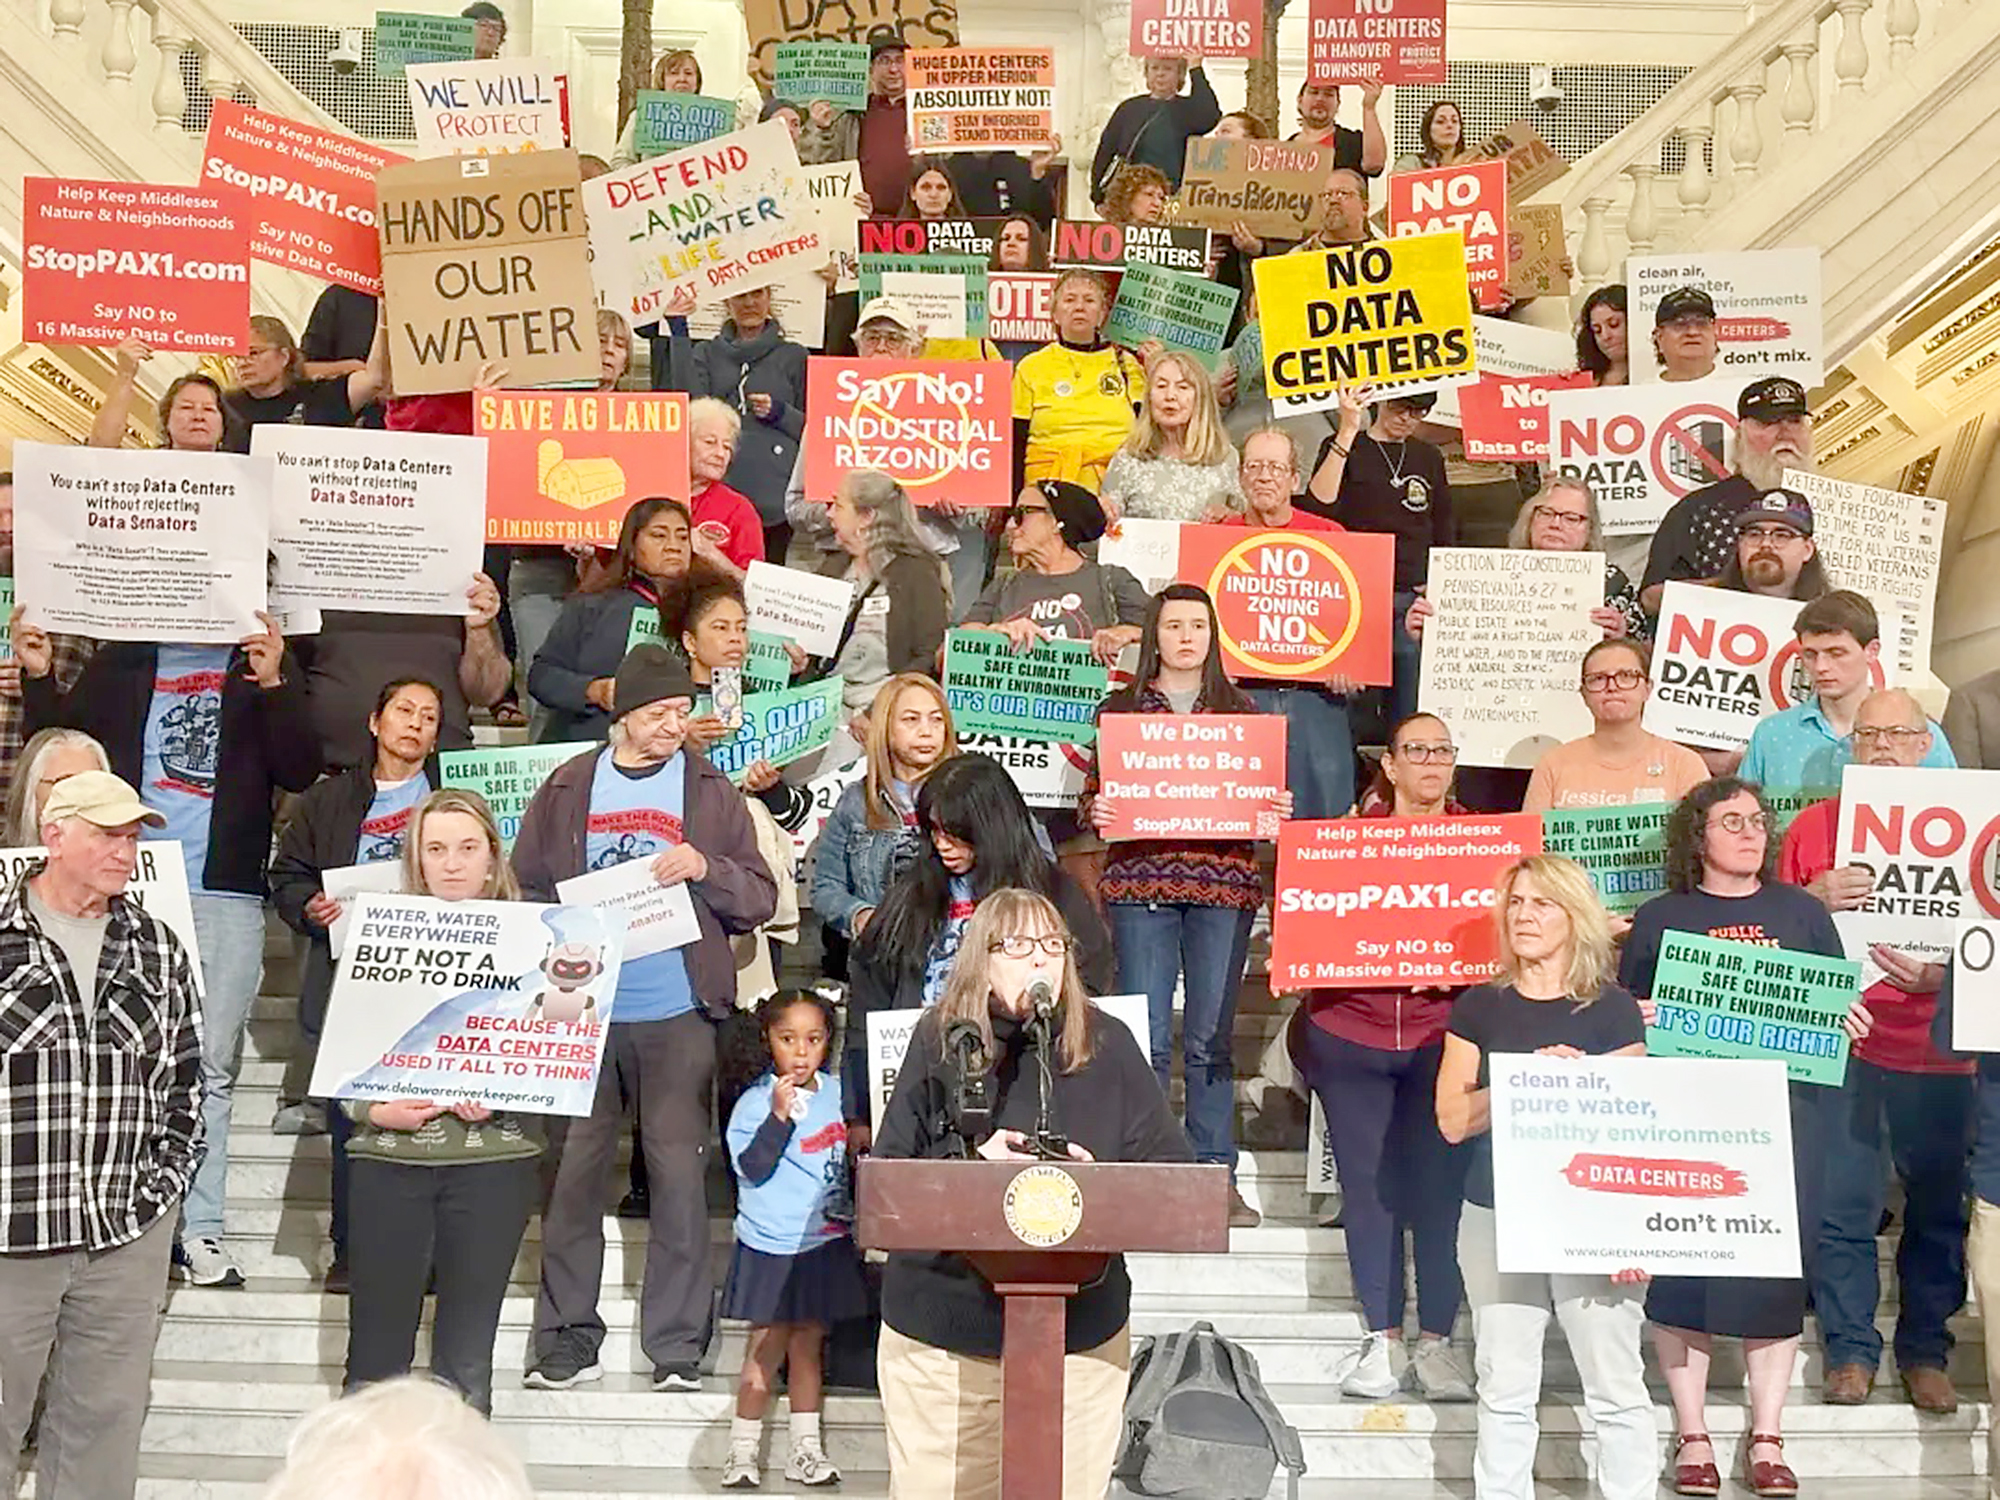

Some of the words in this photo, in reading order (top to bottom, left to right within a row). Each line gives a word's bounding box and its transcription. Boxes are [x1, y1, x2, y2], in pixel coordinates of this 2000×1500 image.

[1142, 21, 1250, 46] CENTERS
[1314, 19, 1358, 38] DATA
[1364, 18, 1441, 38] CENTERS
[913, 57, 949, 70] HUGE
[951, 56, 986, 69] DATA
[990, 55, 1049, 68] CENTERS
[1314, 43, 1326, 58] IN
[1331, 42, 1391, 57] HANOVER
[1314, 64, 1383, 78] TOWNSHIP.
[415, 78, 469, 108] WE
[476, 75, 552, 106] WILL
[913, 90, 1011, 108] ABSOLUTELY
[1016, 90, 1051, 107] NOT!
[437, 113, 542, 139] PROTECT
[606, 145, 749, 208] DEFEND
[58, 186, 95, 202] Help
[98, 189, 137, 206] Keep
[141, 190, 219, 209] Middlesex
[1412, 174, 1481, 213] NO
[41, 205, 94, 221] Nature
[98, 208, 112, 222] &
[116, 208, 234, 231] Neighborhoods
[382, 193, 504, 244] HANDS
[517, 188, 576, 233] OFF
[677, 197, 784, 245] WATER
[862, 222, 926, 255] NO
[927, 222, 975, 238] DATA
[1058, 220, 1122, 262] NO
[1125, 226, 1172, 246] DATA
[28, 244, 247, 283] StopPAX1.com
[659, 238, 726, 280] LIFE
[707, 261, 749, 287] DATA
[747, 233, 820, 265] CENTERS
[1124, 245, 1203, 268] CENTERS.
[1325, 246, 1392, 289] NO
[434, 255, 536, 300] OUR
[1638, 267, 1677, 278] clean
[1683, 265, 1705, 278] air,
[94, 303, 126, 321] Say
[128, 305, 155, 321] NO
[159, 308, 177, 323] to
[1306, 289, 1423, 339] DATA
[36, 321, 54, 336] 16
[60, 324, 126, 341] Massive
[173, 330, 235, 348] Centers
[404, 306, 582, 366] WATER
[1271, 329, 1469, 389] CENTERS
[1724, 351, 1769, 365] don't
[1775, 349, 1811, 362] mix.
[836, 369, 906, 411] Say
[916, 373, 984, 405] No!
[1500, 383, 1549, 408] No
[480, 396, 555, 431] SAVE
[562, 398, 598, 431] AG
[607, 398, 682, 432] LAND
[1519, 418, 1538, 430] to
[824, 415, 1002, 442] INDUSTRIAL
[1560, 414, 1645, 457] NO
[834, 446, 991, 471] REZONING
[1469, 440, 1516, 455] Data
[50, 473, 71, 490] You
[76, 478, 109, 492] can't
[112, 482, 141, 495] stop
[143, 478, 177, 494] Data
[180, 479, 235, 497] Centers
[1785, 472, 1853, 499] VETERANS
[1862, 488, 1914, 510] FOUGHT
[86, 497, 141, 512] without
[142, 499, 200, 515] rejecting
[87, 512, 125, 530] Data
[130, 514, 197, 532] Senators
[502, 518, 604, 539] INDUSTRIAL
[1834, 516, 1858, 535] TIME
[1864, 525, 1886, 539] FOR
[1894, 529, 1910, 543] US
[1260, 548, 1310, 578] NO
[1840, 537, 1862, 552] FOR
[1867, 541, 1882, 557] ALL
[1886, 546, 1937, 565] VETERANS
[1867, 558, 1929, 580] VETERANS
[1226, 576, 1345, 599] INDUSTRIAL
[1845, 572, 1878, 589] THEIR
[1882, 578, 1923, 598] RIGHTS
[1247, 596, 1320, 616] ZONING
[1258, 614, 1307, 643] NO
[1667, 613, 1769, 667] NO
[1240, 640, 1270, 653] DATA
[1271, 642, 1325, 656] CENTERS
[1661, 659, 1763, 700] DATA
[768, 695, 826, 733] OUR
[1656, 686, 1761, 718] CENTERS
[1139, 722, 1176, 741] We
[1182, 722, 1244, 741] Don't
[711, 722, 814, 772] RIGHT!
[1121, 751, 1182, 770] Want
[1186, 754, 1210, 770] to
[1216, 752, 1244, 770] Be
[1249, 756, 1262, 770] a
[1104, 781, 1150, 798] Data
[1154, 781, 1219, 798] Center
[1222, 782, 1277, 799] Town
[1554, 789, 1627, 807] Jessica
[1133, 817, 1250, 835] StopPAX1.com
[1552, 821, 1580, 835] AIR,
[1586, 818, 1621, 833] PURE
[1851, 803, 1967, 859] NO
[1542, 838, 1575, 852] SAFE
[1581, 834, 1640, 851] CLIMATE
[366, 907, 431, 925] WATER,
[436, 912, 501, 930] WATER,
[1708, 925, 1765, 938] PUBLIC
[361, 923, 499, 946] EVERYWHERE
[354, 945, 410, 967] BUT
[415, 947, 471, 971] NOT
[477, 953, 496, 971] A
[1665, 944, 1712, 966] CLEAN
[1716, 954, 1747, 974] AIR,
[1754, 959, 1795, 981] PURE
[1800, 968, 1855, 989] WATER
[350, 965, 413, 984] DROP
[418, 969, 448, 987] TO
[453, 973, 524, 993] DRINK
[1701, 972, 1738, 991] SAFE
[1744, 978, 1810, 1004] CLIMATE
[1657, 984, 1724, 1010] HEALTHY
[1729, 997, 1848, 1030] ENVIRONMENTS
[465, 1015, 558, 1036] BECAUSE
[564, 1021, 602, 1039] THE
[1655, 1004, 1699, 1035] IT'S
[1706, 1014, 1755, 1045] OUR
[1760, 1022, 1841, 1059] RIGHT!
[435, 1035, 492, 1054] DATA
[499, 1040, 598, 1061] CENTERS
[381, 1053, 433, 1071] USED
[437, 1057, 455, 1072] IT
[459, 1058, 498, 1076] ALL
[502, 1062, 529, 1077] TO
[535, 1063, 593, 1082] THINK
[350, 1080, 556, 1107] www.delawareriverkeeper.org
[1509, 1071, 1570, 1088] clean
[1575, 1072, 1611, 1092] air,
[1509, 1097, 1571, 1117] pure
[1577, 1100, 1658, 1119] water,
[1509, 1122, 1600, 1143] healthy
[1606, 1126, 1772, 1145] environments
[1589, 1165, 1636, 1186] DATA
[1640, 1168, 1725, 1191] CENTERS
[1645, 1212, 1718, 1235] don't
[1725, 1215, 1782, 1235] mix.
[1563, 1247, 1736, 1261] WWW.GREENAMENDMENT.ORG
